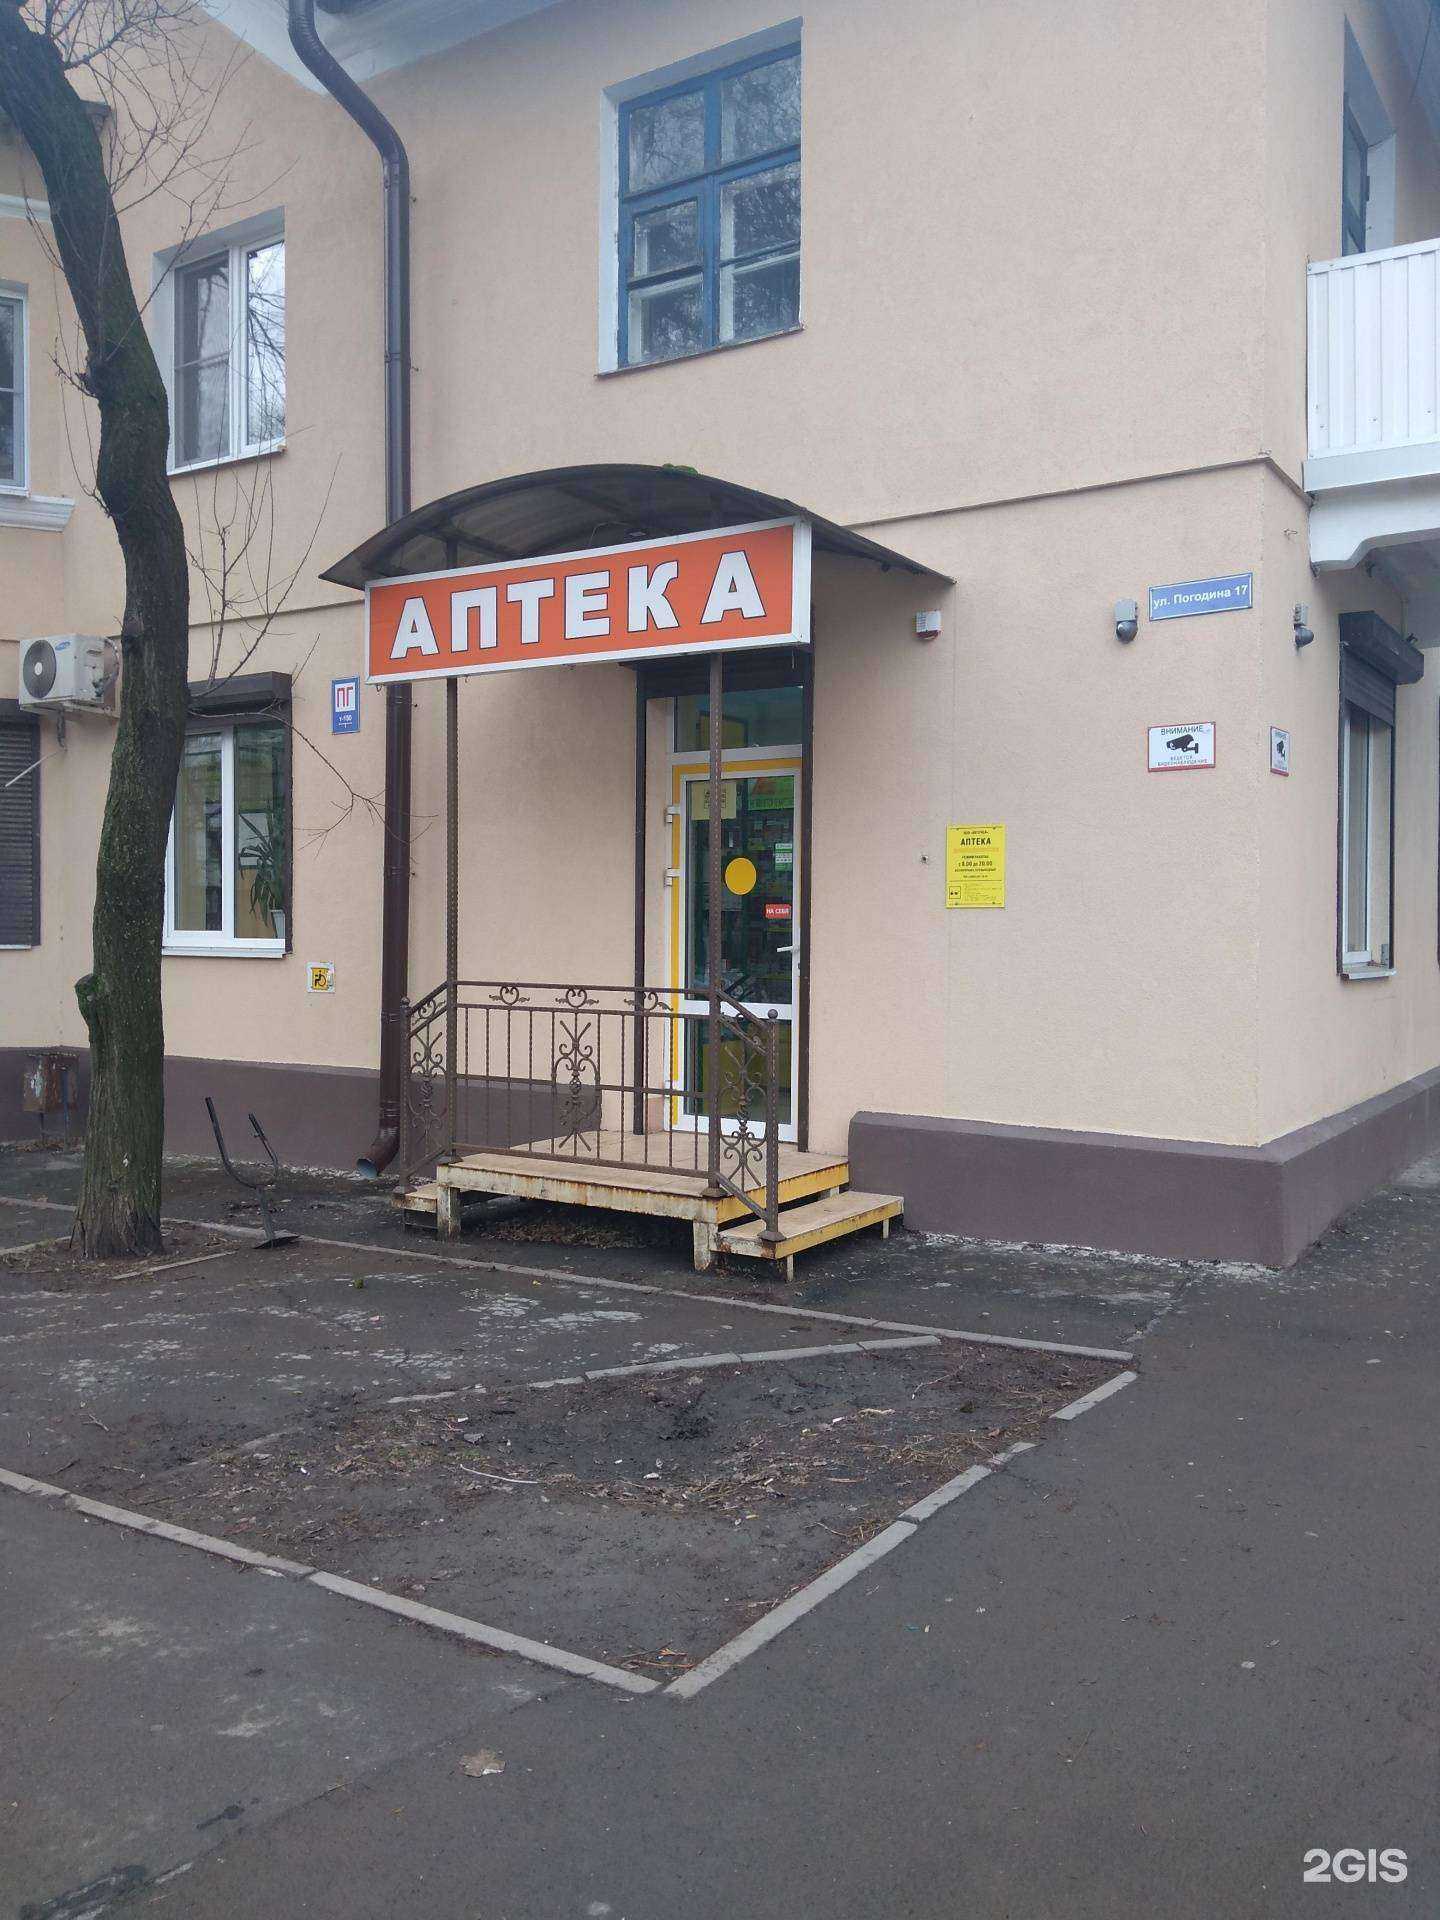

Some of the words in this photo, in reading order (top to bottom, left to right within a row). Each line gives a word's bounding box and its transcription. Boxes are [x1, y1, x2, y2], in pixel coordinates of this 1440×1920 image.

[389, 549, 767, 660] АПТЕКА
[1153, 598, 1170, 609] ул.
[1173, 588, 1231, 604] Погодина
[1234, 584, 1248, 596] 17
[336, 686, 354, 708] ПГ
[1161, 725, 1203, 736] ВНИМАНИЕ
[960, 837, 991, 846] АПТЕКА
